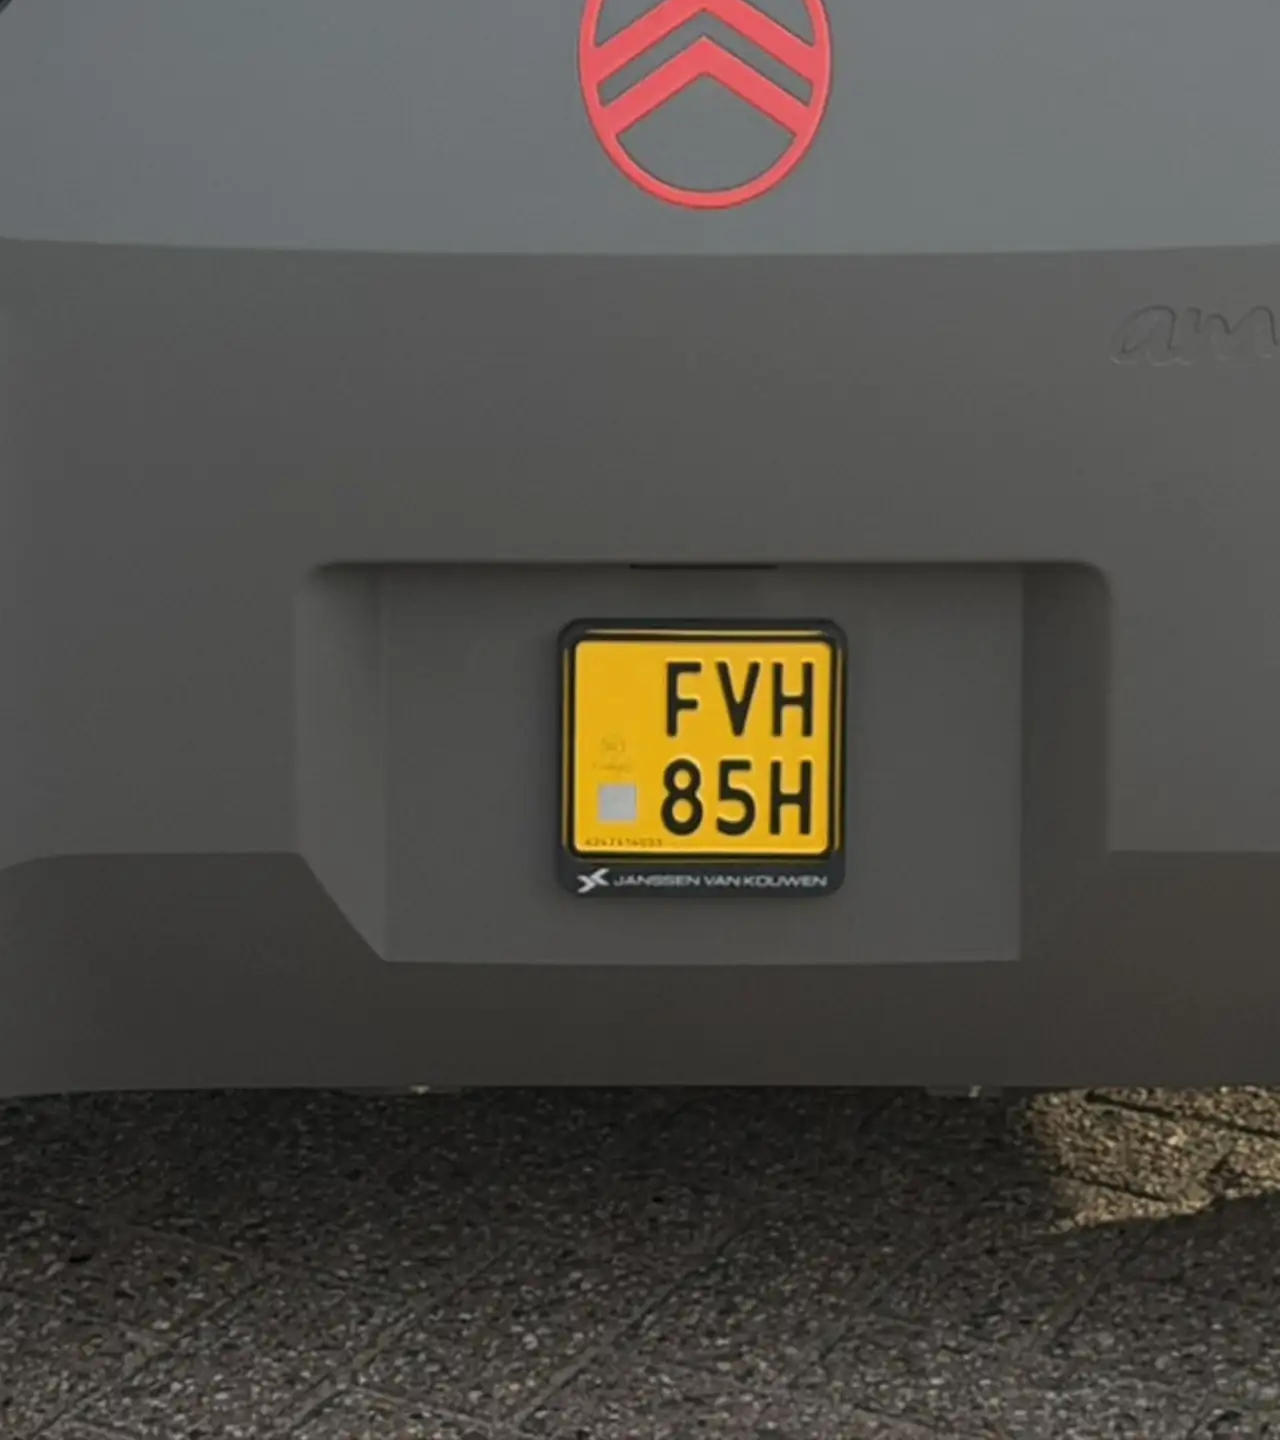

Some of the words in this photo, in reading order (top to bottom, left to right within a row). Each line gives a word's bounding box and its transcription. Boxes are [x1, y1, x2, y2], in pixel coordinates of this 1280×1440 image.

[666, 661, 814, 737] FVH
[660, 758, 812, 836] 85H
[613, 873, 700, 888] JANSSEN
[704, 873, 740, 888] VAN
[743, 873, 828, 888] KOUWEN
